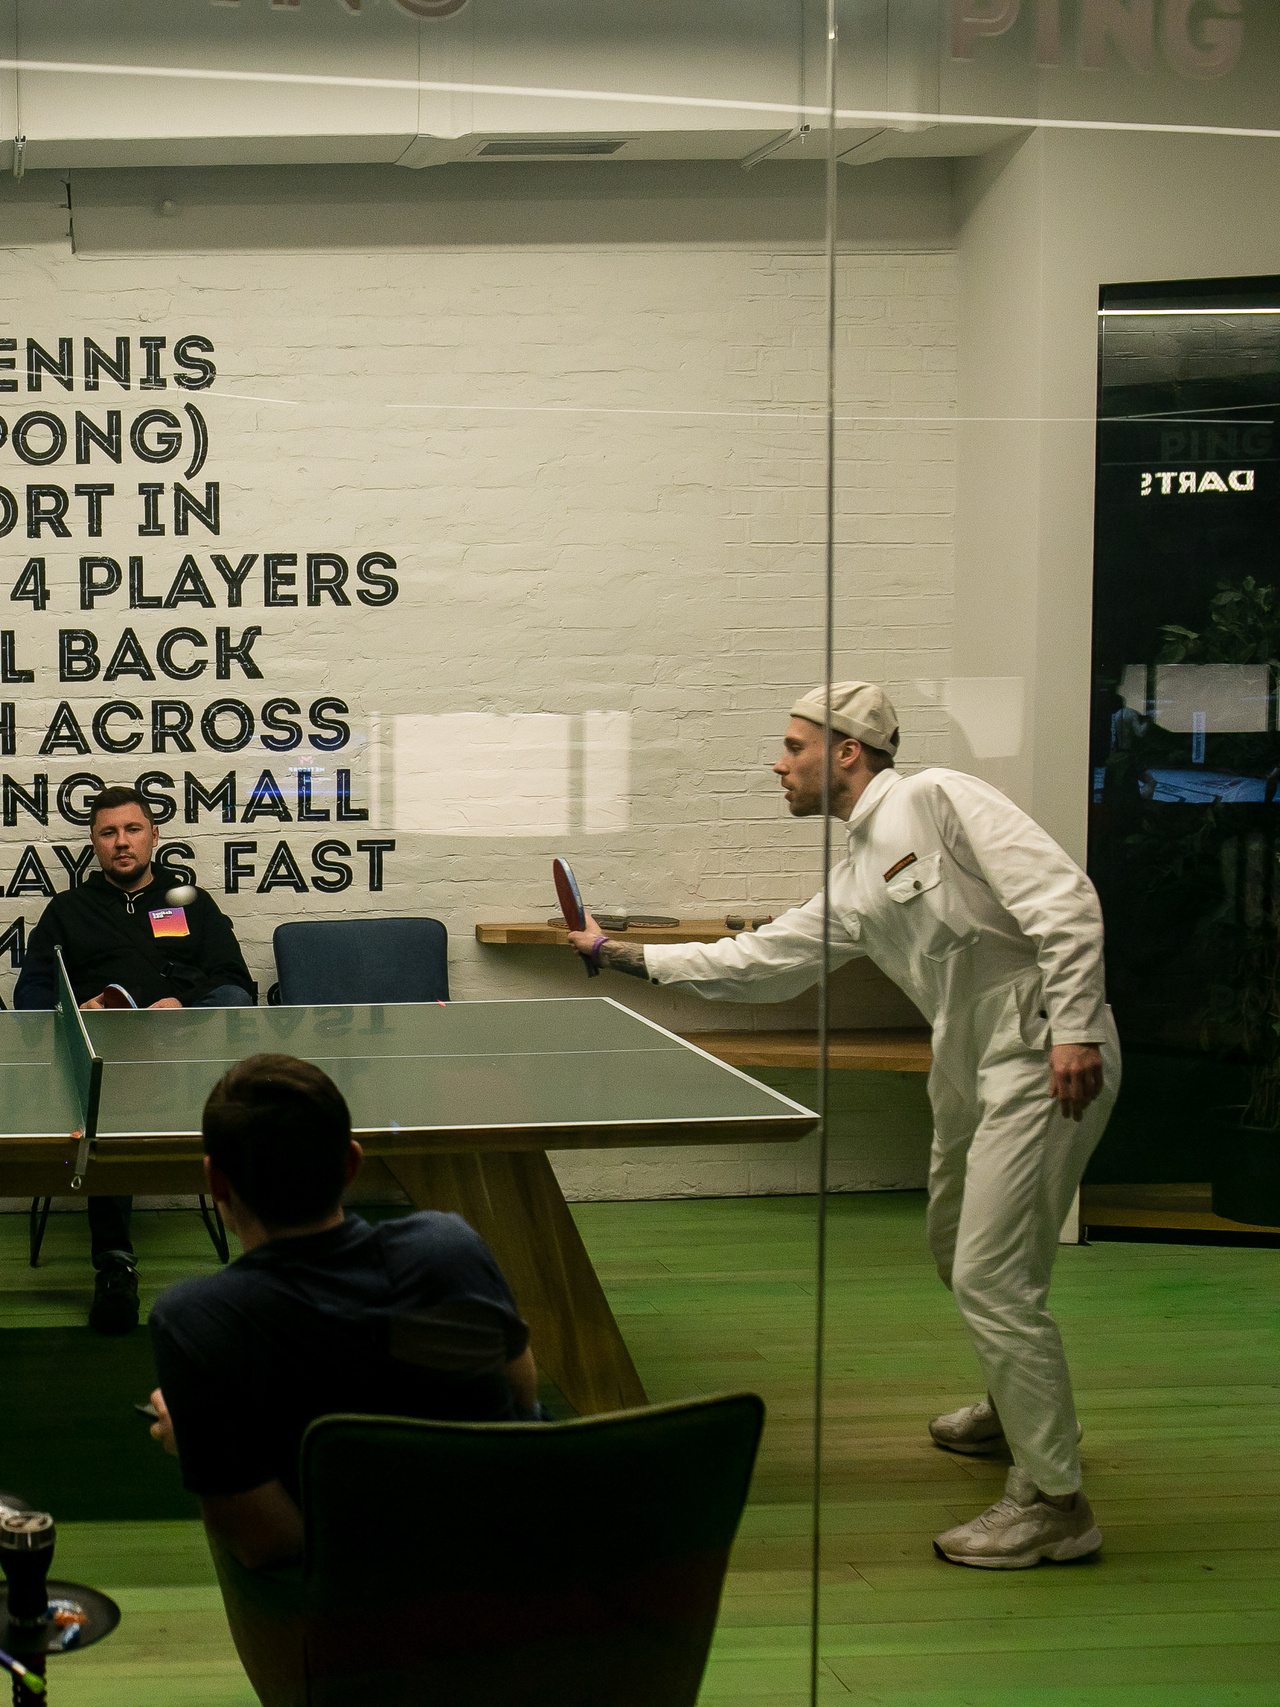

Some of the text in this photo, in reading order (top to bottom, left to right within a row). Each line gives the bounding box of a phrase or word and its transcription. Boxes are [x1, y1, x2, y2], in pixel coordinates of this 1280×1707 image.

[950, 0, 1245, 80] PING
[138, 481, 220, 537] IN
[10, 556, 52, 612] 4
[80, 551, 400, 611] PLAYERS
[58, 625, 265, 683] BACK
[39, 696, 351, 755] ACROSS
[134, 767, 369, 826] SMALL
[154, 841, 198, 888] S
[222, 839, 396, 894] FAST
